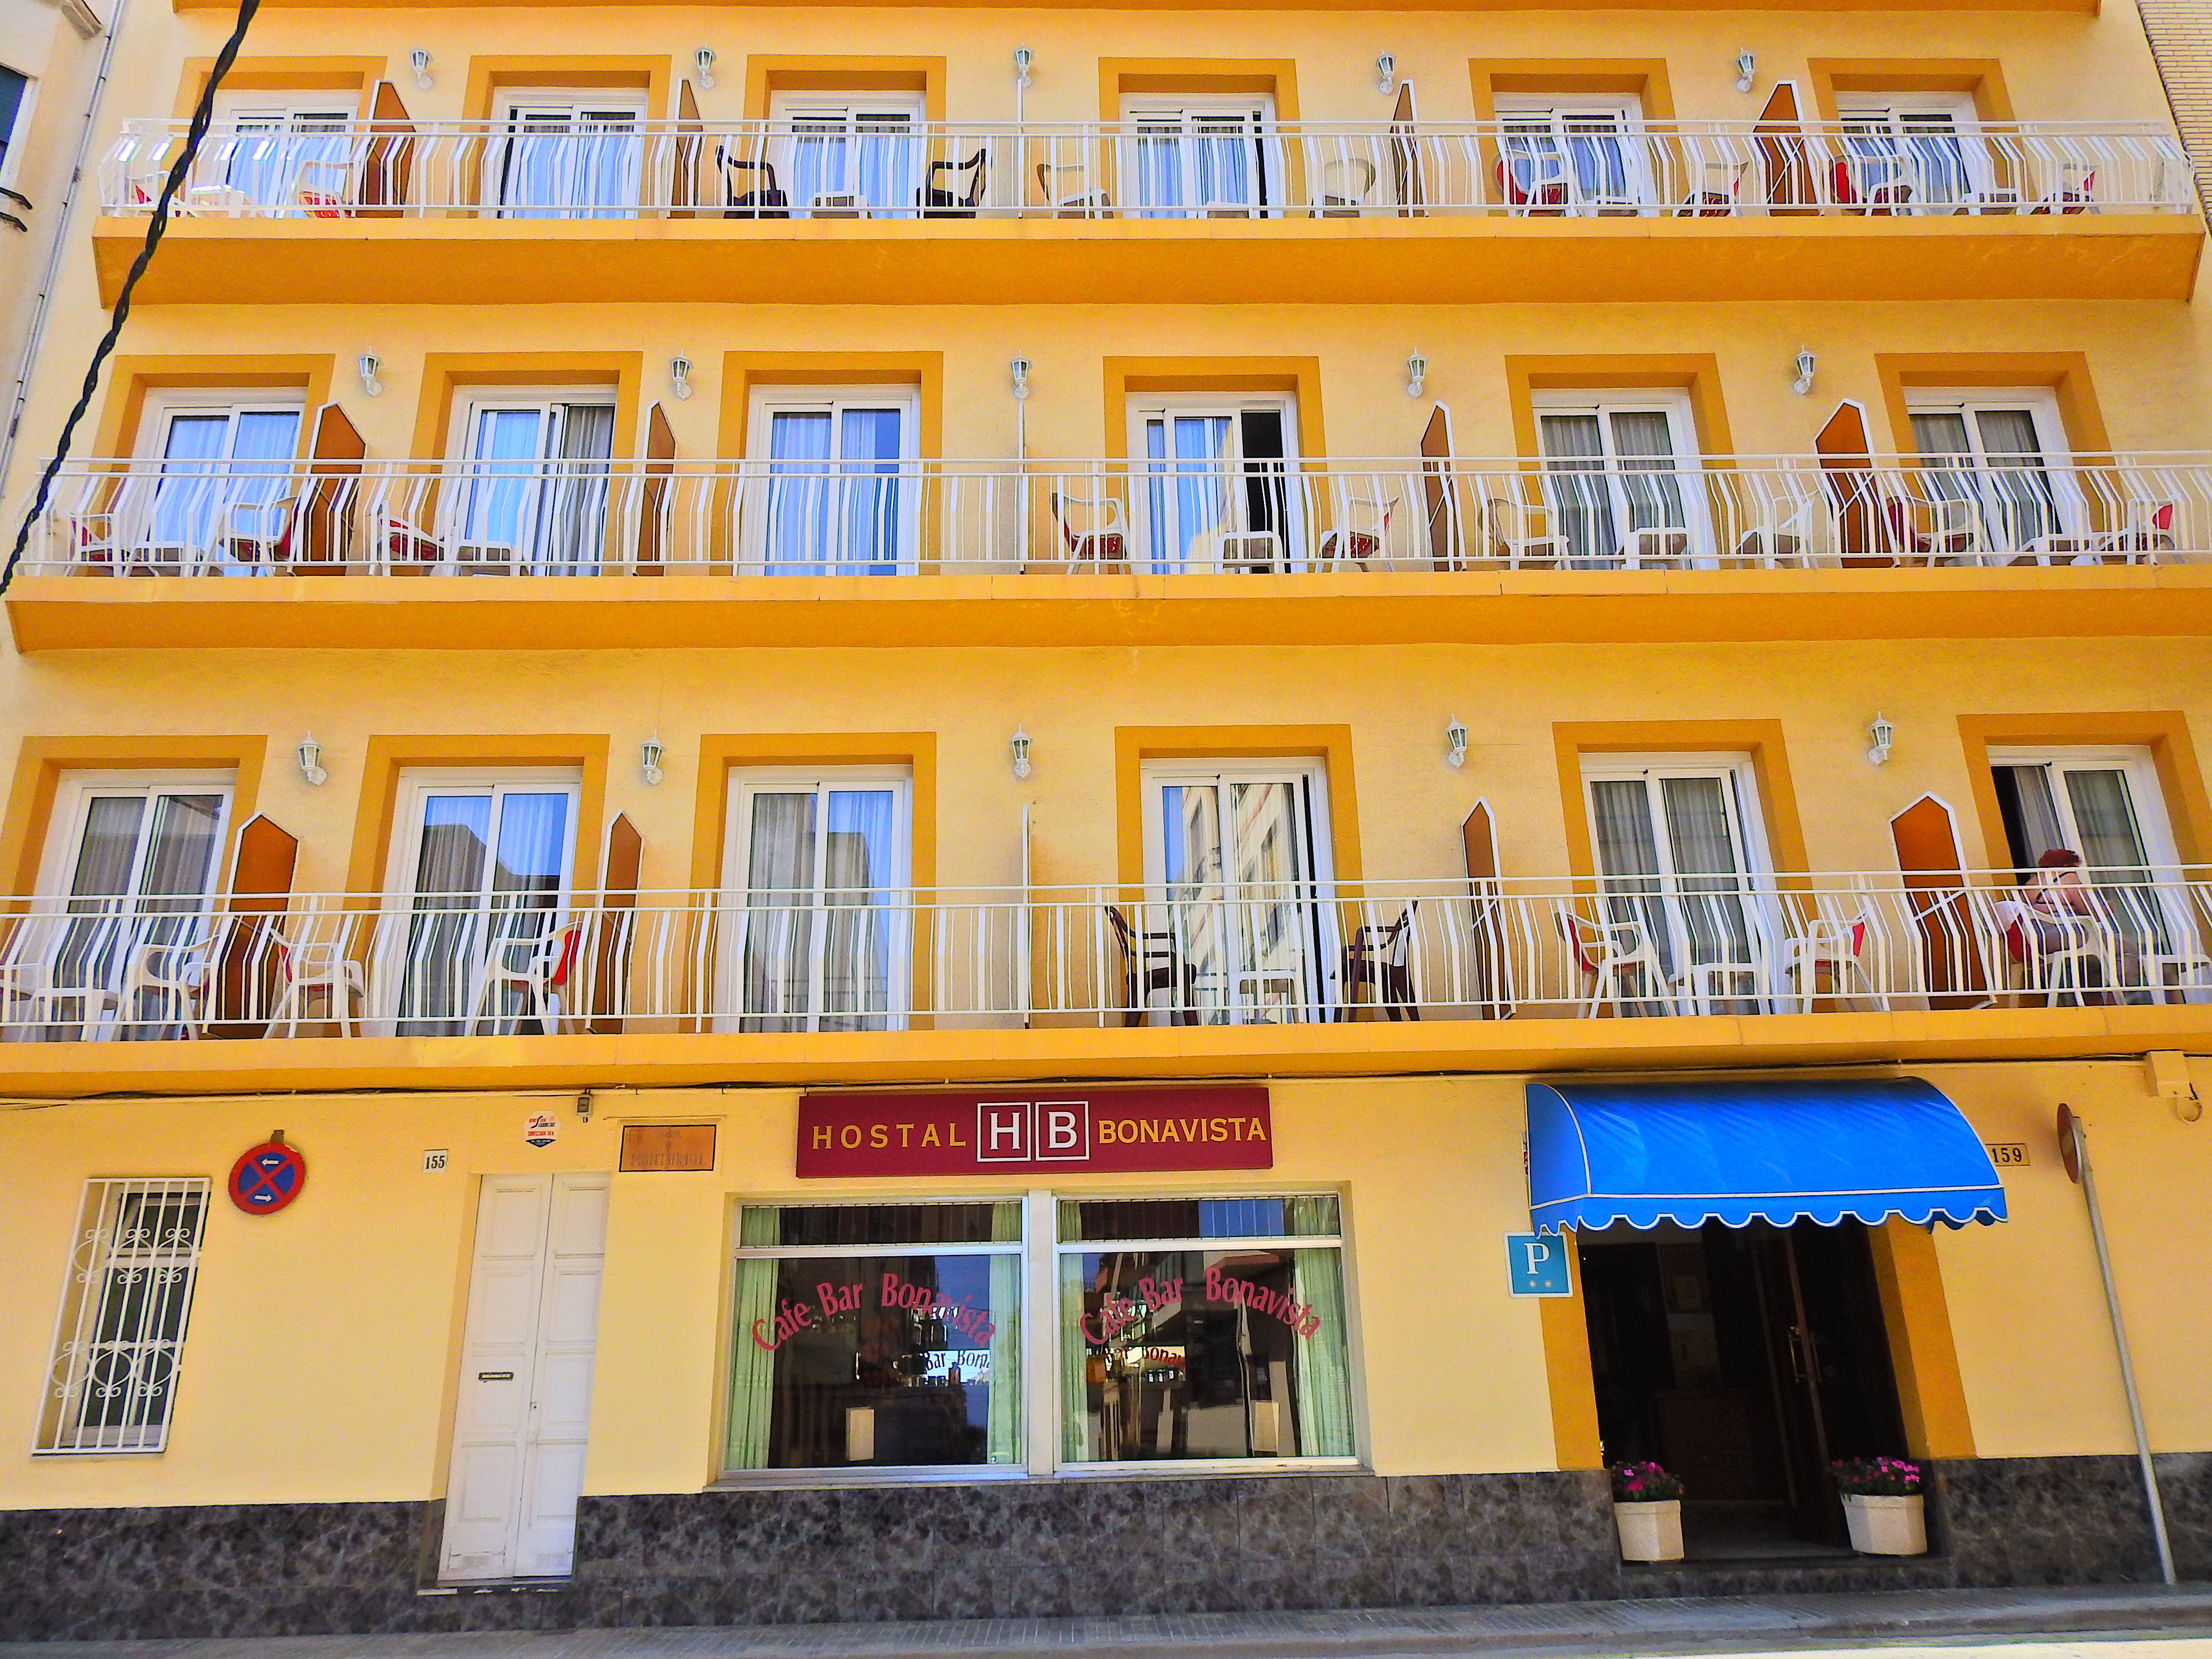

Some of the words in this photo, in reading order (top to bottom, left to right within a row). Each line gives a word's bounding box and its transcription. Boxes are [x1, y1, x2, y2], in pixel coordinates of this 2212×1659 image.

[812, 1123, 966, 1149] HOSTAL
[1098, 1117, 1267, 1144] BONAVISTA
[426, 1155, 445, 1169] 155
[1992, 1147, 2022, 1163] 159
[1524, 1242, 1551, 1274] P
[752, 1298, 812, 1351] Cafe
[816, 1282, 863, 1316] Bar
[881, 1273, 996, 1347] Bonavista
[1080, 1294, 1137, 1345] Cafe
[1138, 1277, 1184, 1310] Bar
[1204, 1266, 1320, 1340] Bonavista
